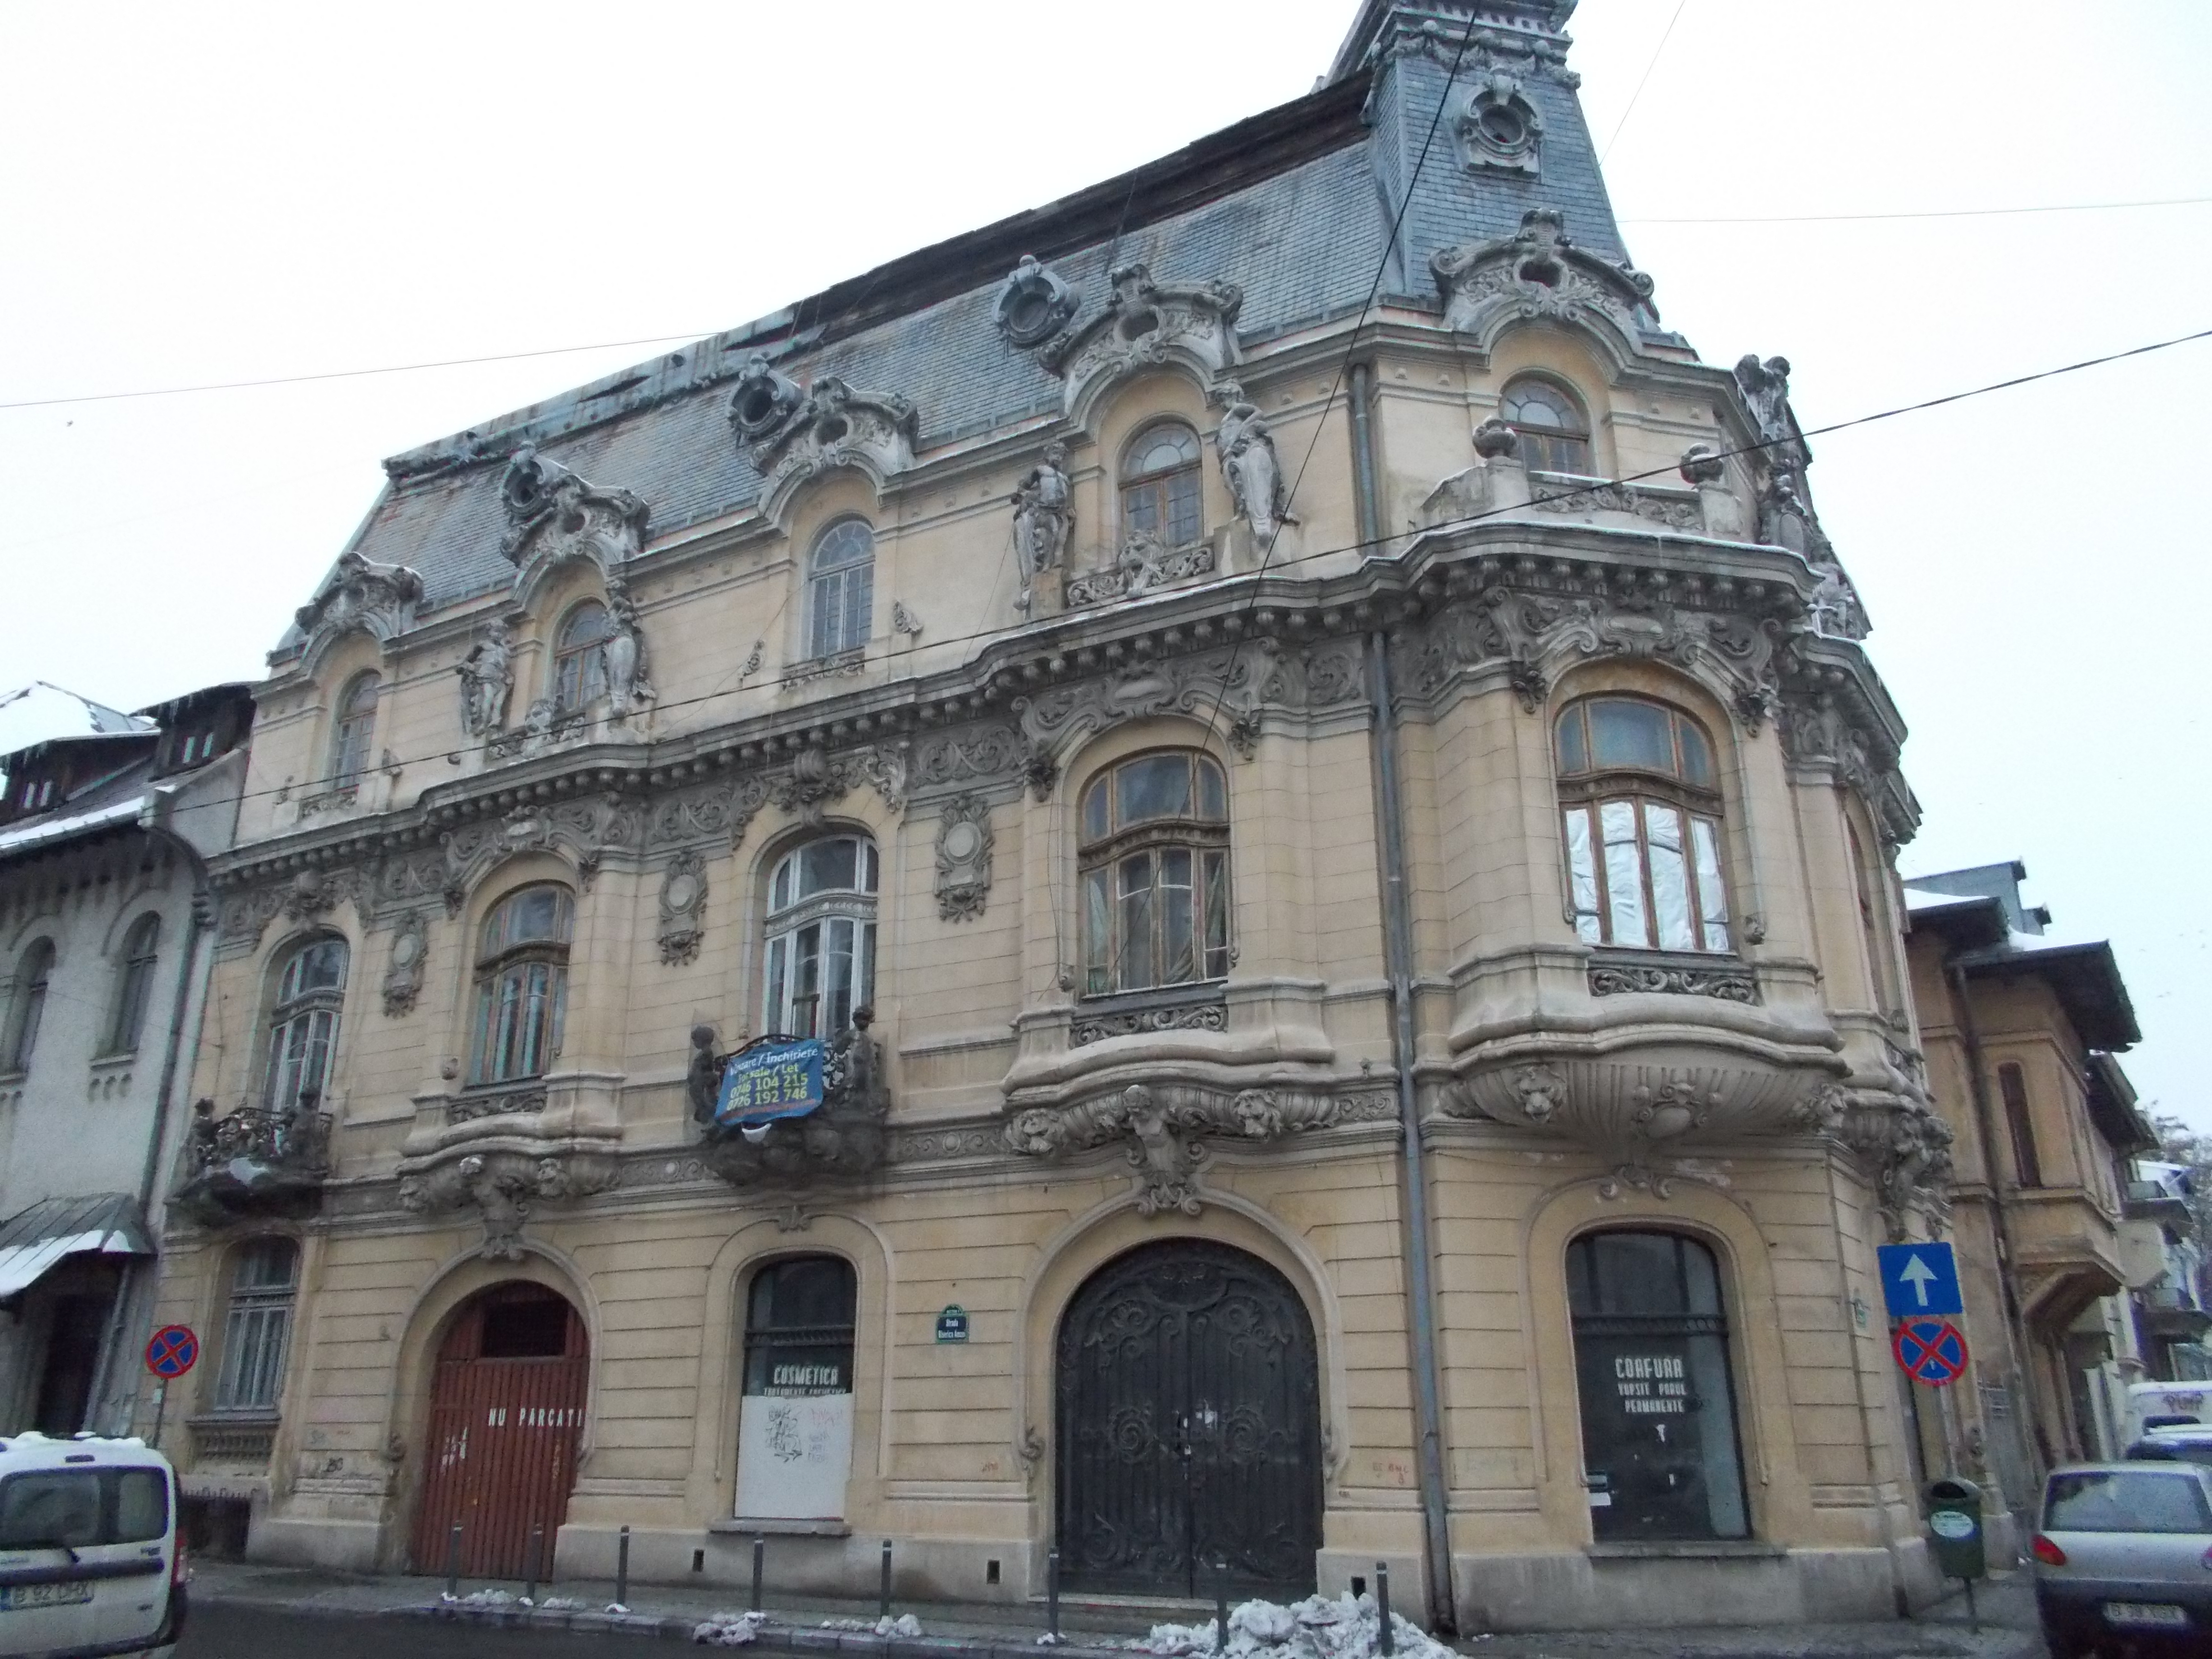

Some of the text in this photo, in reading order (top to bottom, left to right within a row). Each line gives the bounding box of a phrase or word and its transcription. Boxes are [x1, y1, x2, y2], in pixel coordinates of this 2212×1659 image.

[750, 1066, 770, 1078] sale
[782, 1063, 798, 1073] Let
[756, 1076, 779, 1090] 104
[783, 1072, 808, 1087] 215
[755, 1090, 780, 1105] 192
[784, 1086, 807, 1101] 746
[946, 1319, 958, 1327] Strada
[773, 1366, 839, 1385] COSMETICA
[1615, 1358, 1683, 1379] COAFURA
[1624, 1399, 1684, 1413] PERMANENTE
[488, 1408, 582, 1427] NU PARCATI
